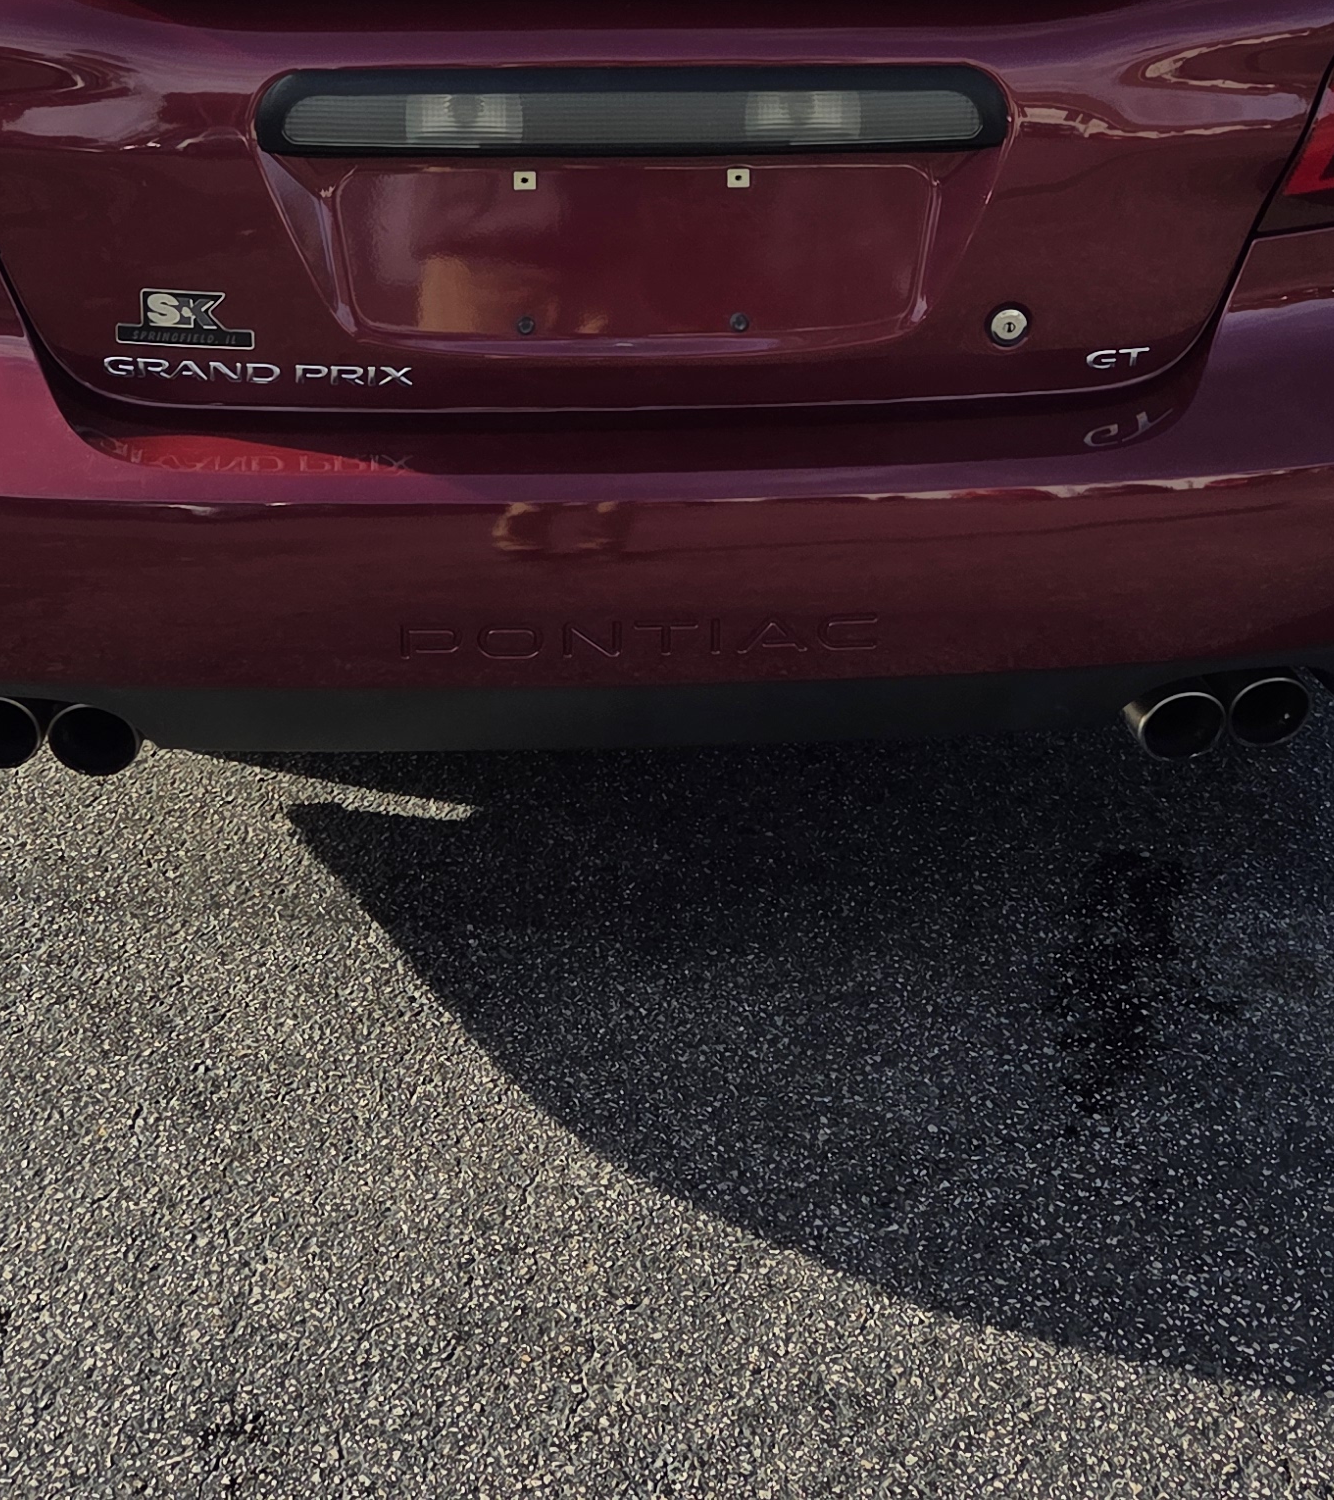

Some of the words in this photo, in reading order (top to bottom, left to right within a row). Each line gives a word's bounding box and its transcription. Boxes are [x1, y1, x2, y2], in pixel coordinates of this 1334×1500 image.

[225, 335, 237, 345] IL
[103, 356, 281, 384] GRAND
[295, 363, 413, 387] PRIX
[1085, 346, 1151, 370] GT
[398, 611, 879, 660] PONTIAC
